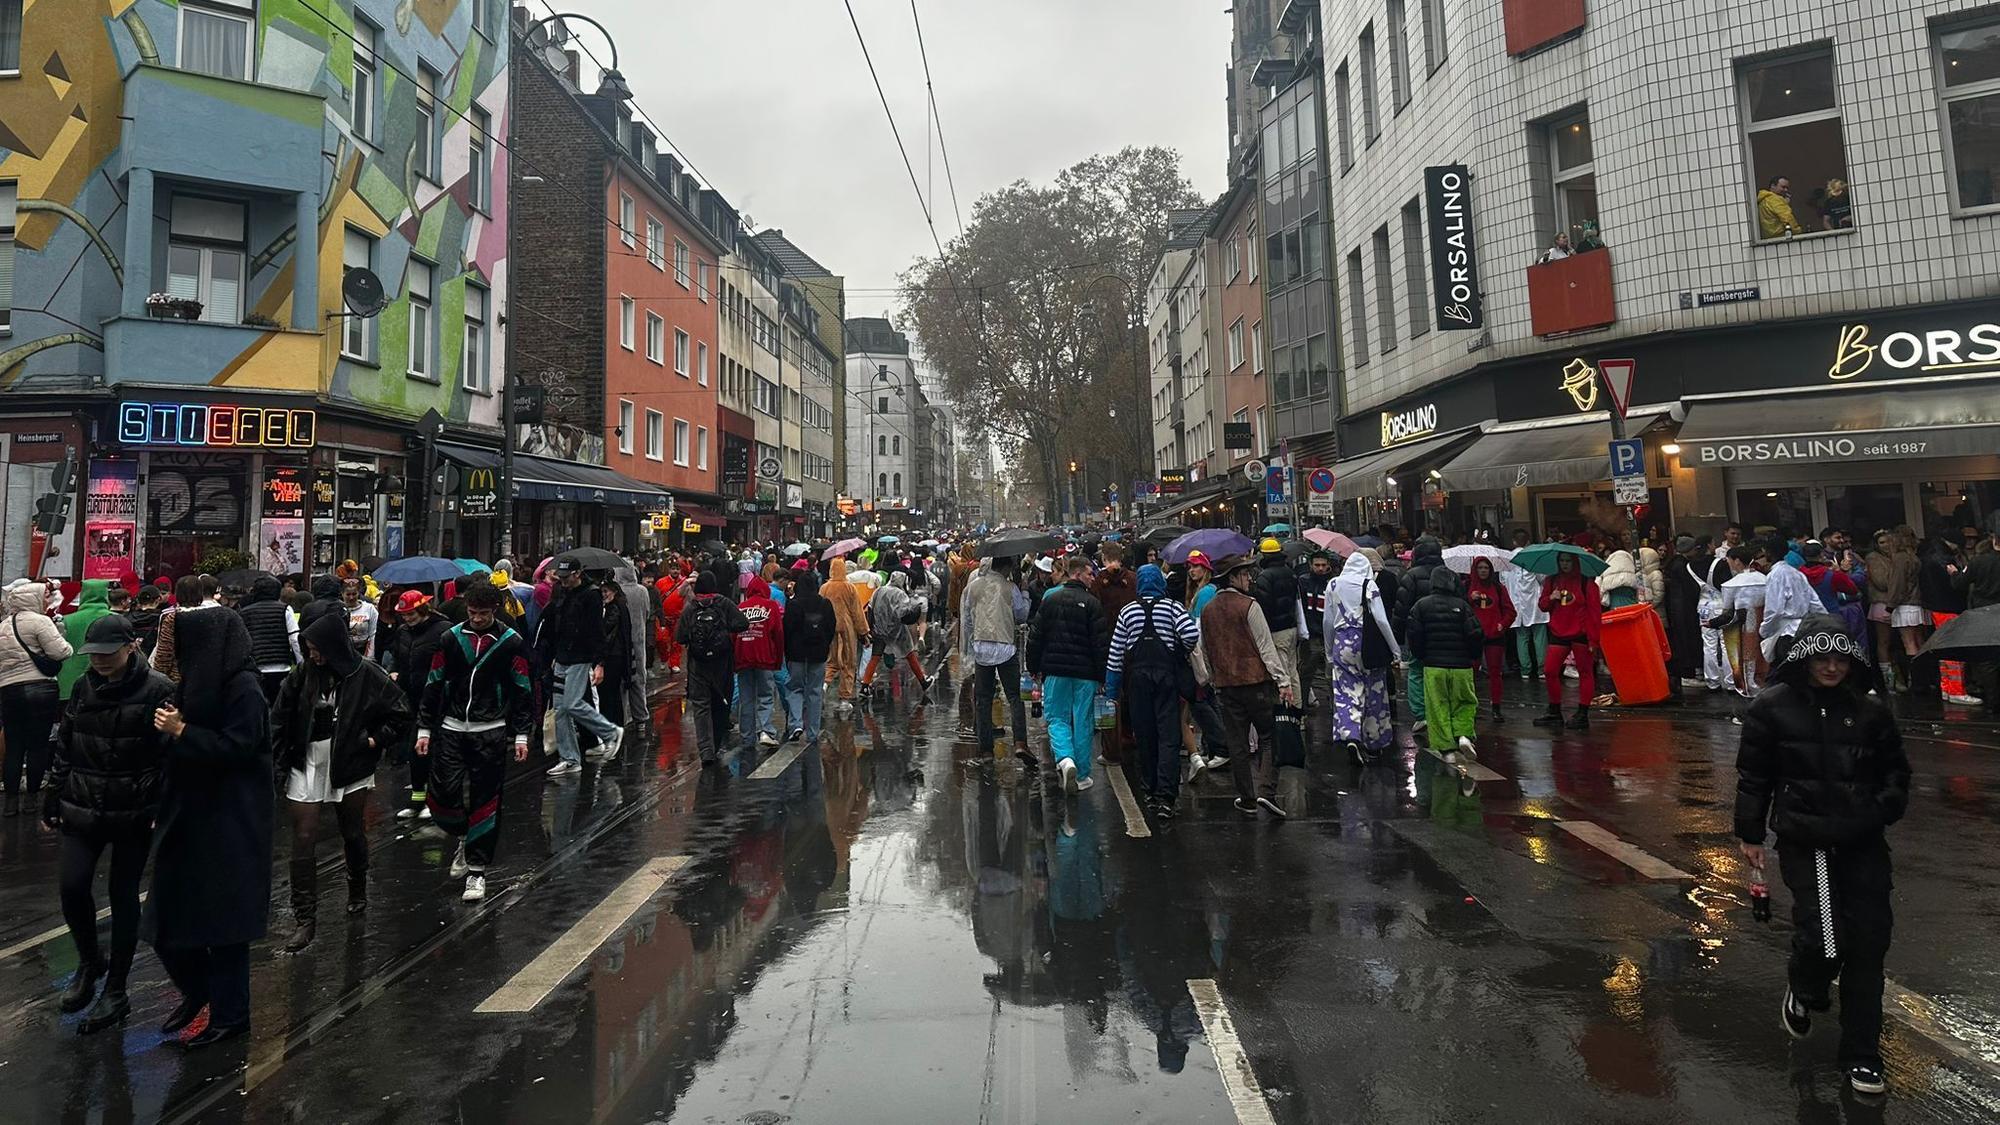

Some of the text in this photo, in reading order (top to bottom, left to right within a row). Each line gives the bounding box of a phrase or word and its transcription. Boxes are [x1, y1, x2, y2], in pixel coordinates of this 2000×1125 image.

[1442, 173, 1472, 324] BORSALINO
[1703, 289, 1754, 303] Heinsbergstr.
[124, 407, 310, 442] STIEFEL
[1381, 403, 1437, 447] BORSALINO
[1616, 444, 1635, 472] P
[1701, 438, 1927, 462] BORSALINO seit 1987
[263, 482, 302, 492] FANTA
[273, 491, 301, 502] VIER
[1269, 493, 1288, 503] TAX
